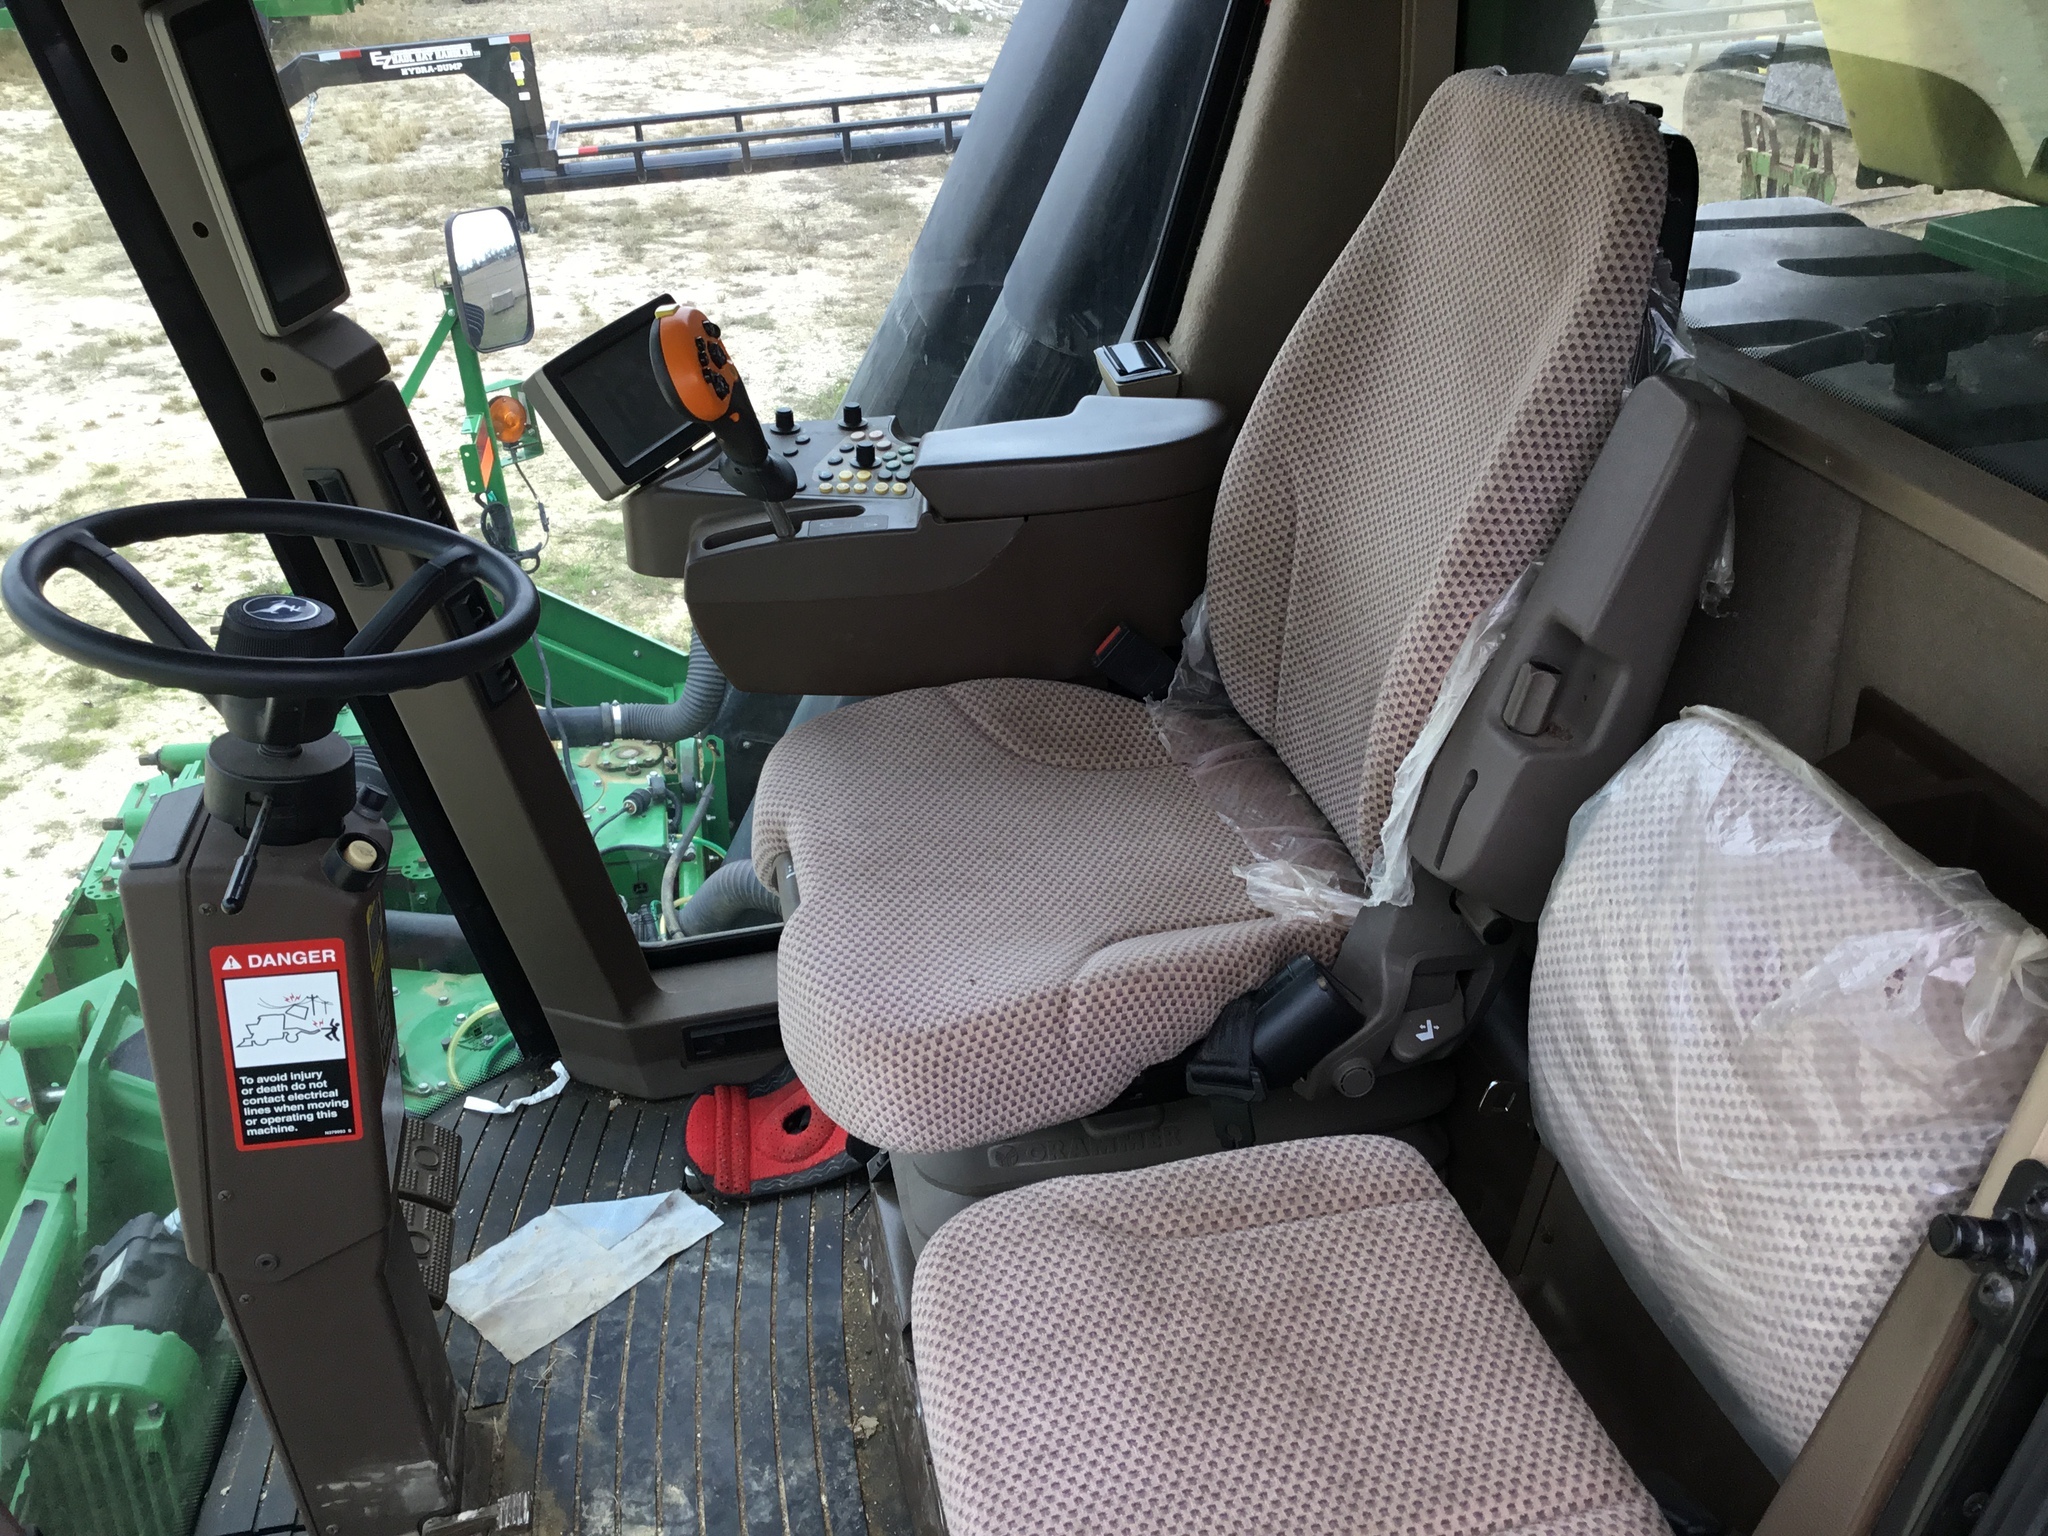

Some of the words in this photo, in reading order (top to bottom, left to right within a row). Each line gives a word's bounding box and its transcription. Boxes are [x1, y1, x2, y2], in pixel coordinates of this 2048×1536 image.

[400, 62, 463, 76] HYDRA-DUMP
[247, 949, 337, 968] DANGER
[239, 1076, 254, 1085] To
[256, 1072, 288, 1084] avoid
[290, 1071, 323, 1081] injury
[241, 1087, 253, 1096] or
[256, 1084, 288, 1094] death
[291, 1082, 306, 1091] do
[308, 1080, 328, 1089] not
[242, 1094, 286, 1106] contact
[287, 1089, 339, 1102] electrical
[243, 1106, 271, 1116] lines
[274, 1103, 305, 1113] when
[307, 1099, 350, 1110] moving
[245, 1118, 257, 1126] or
[260, 1113, 314, 1126] operating
[316, 1110, 338, 1119] this
[246, 1125, 299, 1136] machine.
